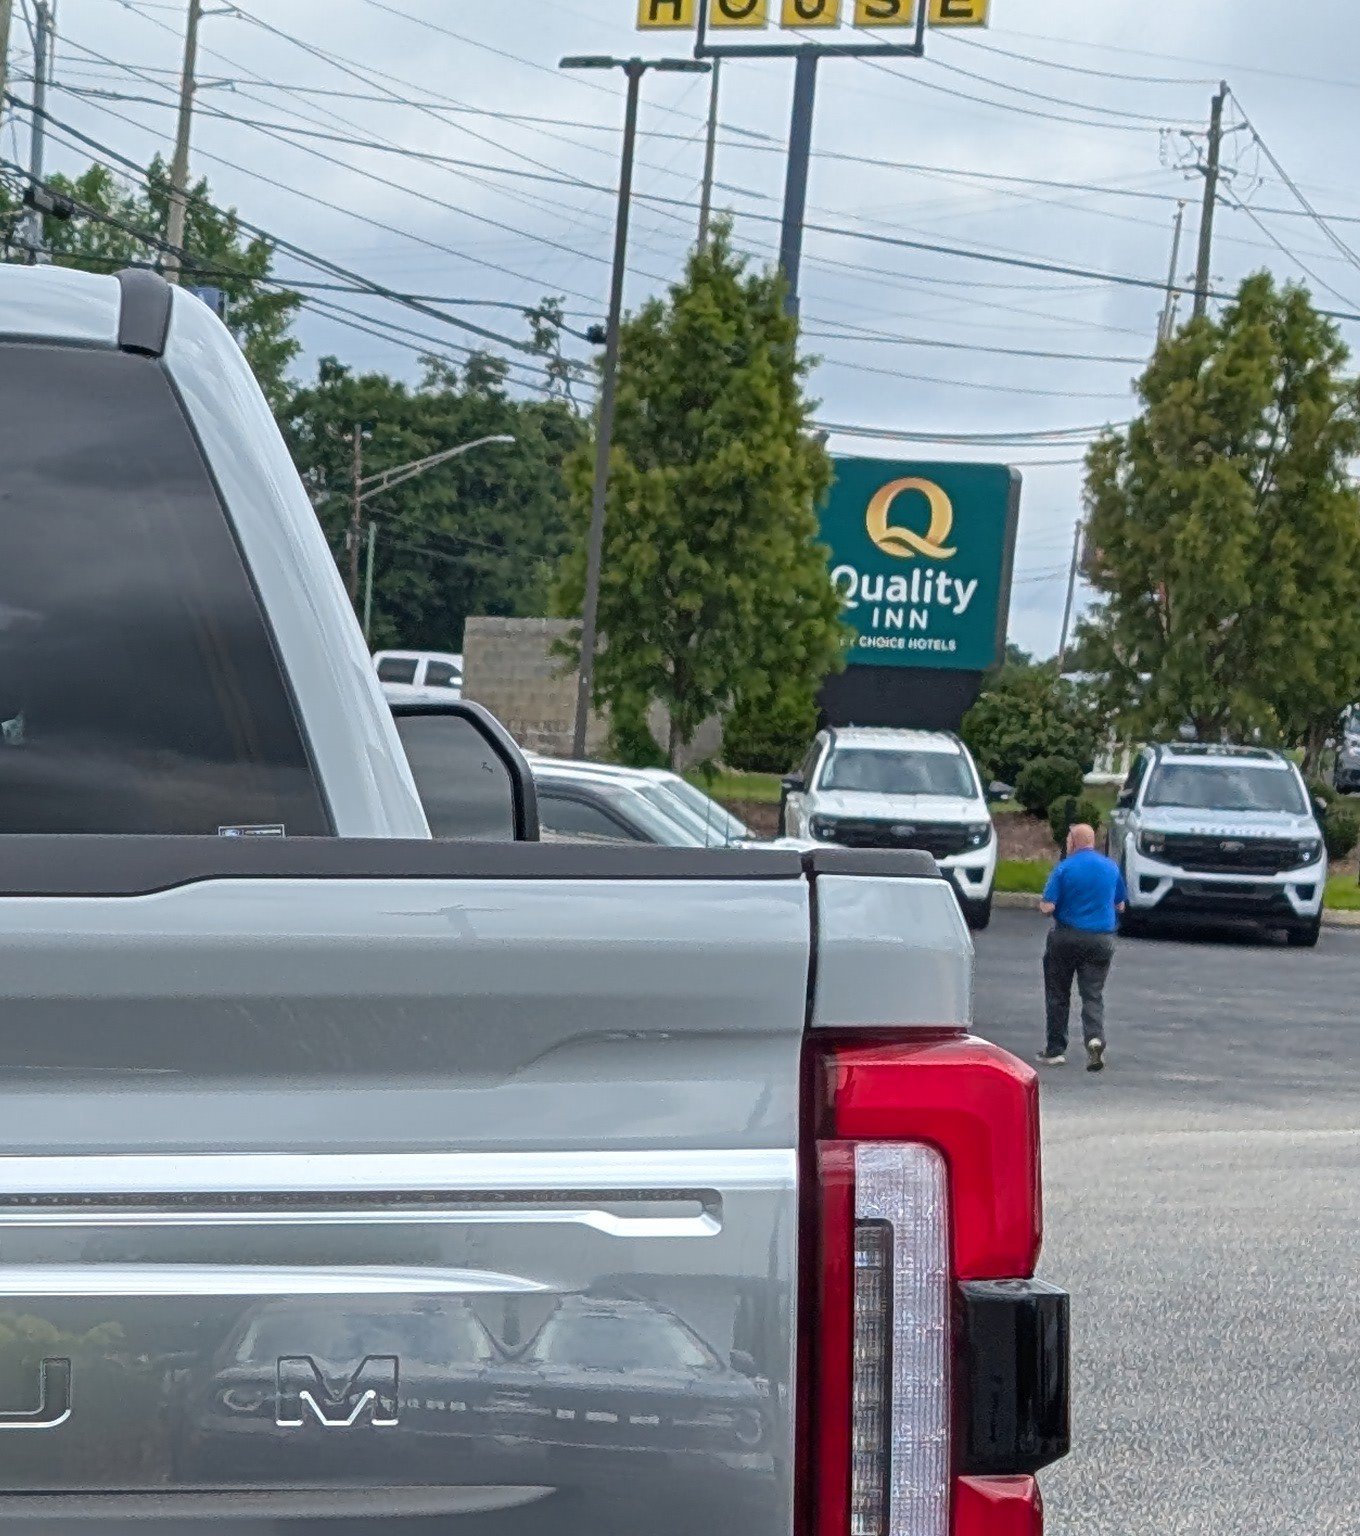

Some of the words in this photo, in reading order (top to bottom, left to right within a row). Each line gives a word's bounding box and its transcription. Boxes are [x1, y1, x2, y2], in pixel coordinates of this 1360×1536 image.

[830, 564, 979, 615] Quality
[872, 606, 929, 631] INN
[859, 635, 905, 650] CHOICE
[908, 637, 957, 652] HOTELS
